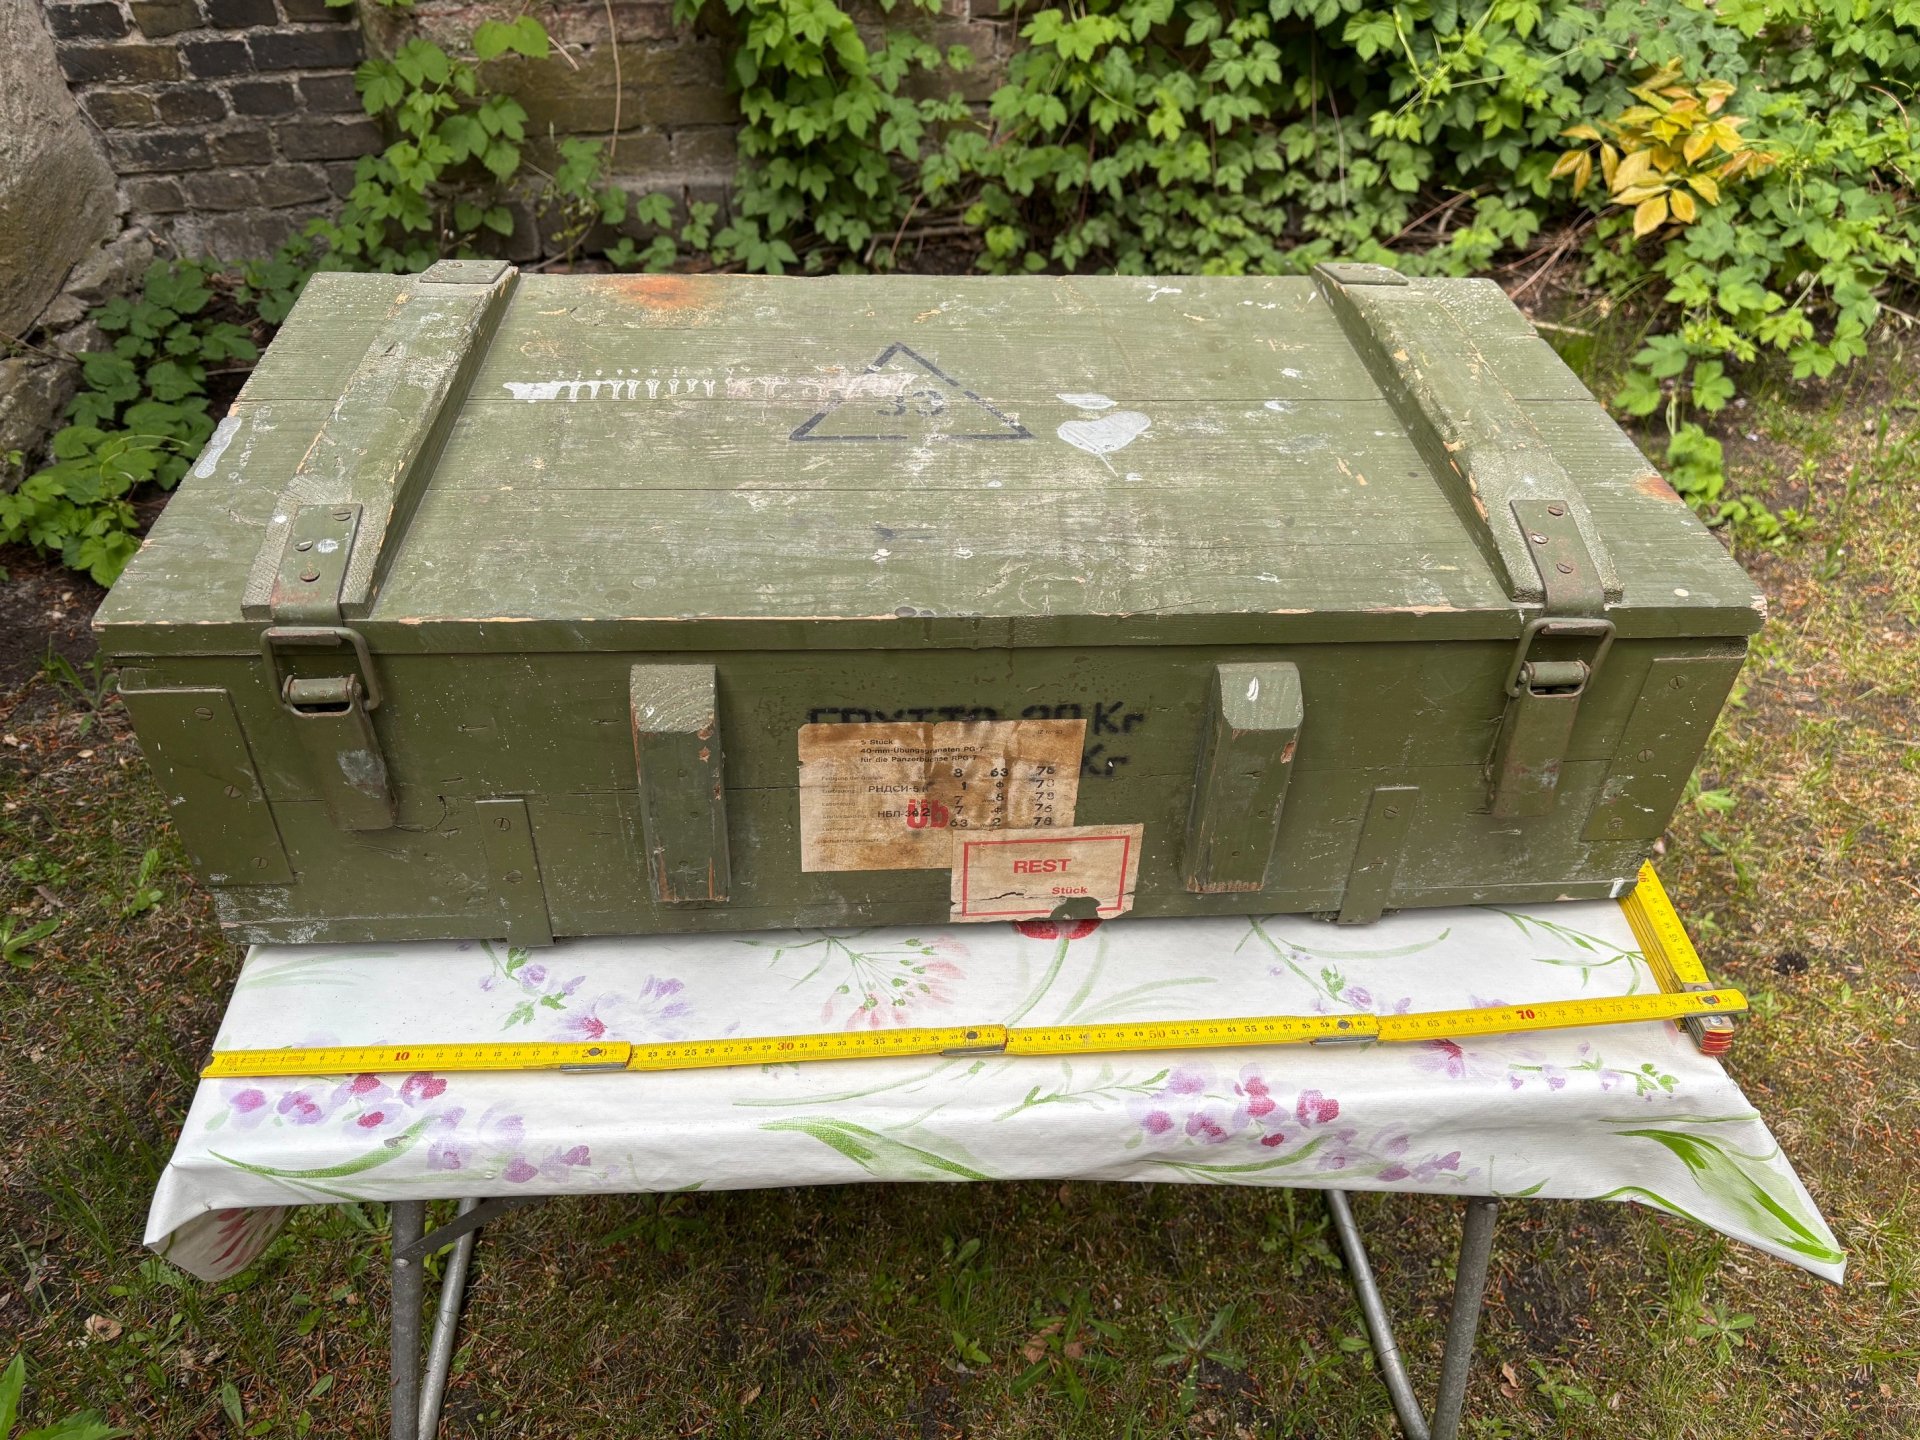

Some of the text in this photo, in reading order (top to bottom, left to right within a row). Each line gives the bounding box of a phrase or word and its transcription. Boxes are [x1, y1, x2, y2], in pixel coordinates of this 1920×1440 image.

[990, 766, 1009, 778] 63
[1012, 858, 1072, 874] REST
[1050, 886, 1090, 896] Stück
[394, 1051, 410, 1061] 10
[684, 1048, 697, 1056] 25
[777, 1042, 794, 1051] 30
[1058, 1034, 1071, 1042] 45
[1149, 1030, 1166, 1039] 50
[1244, 1025, 1257, 1033] 55
[1516, 1009, 1535, 1020] 70
